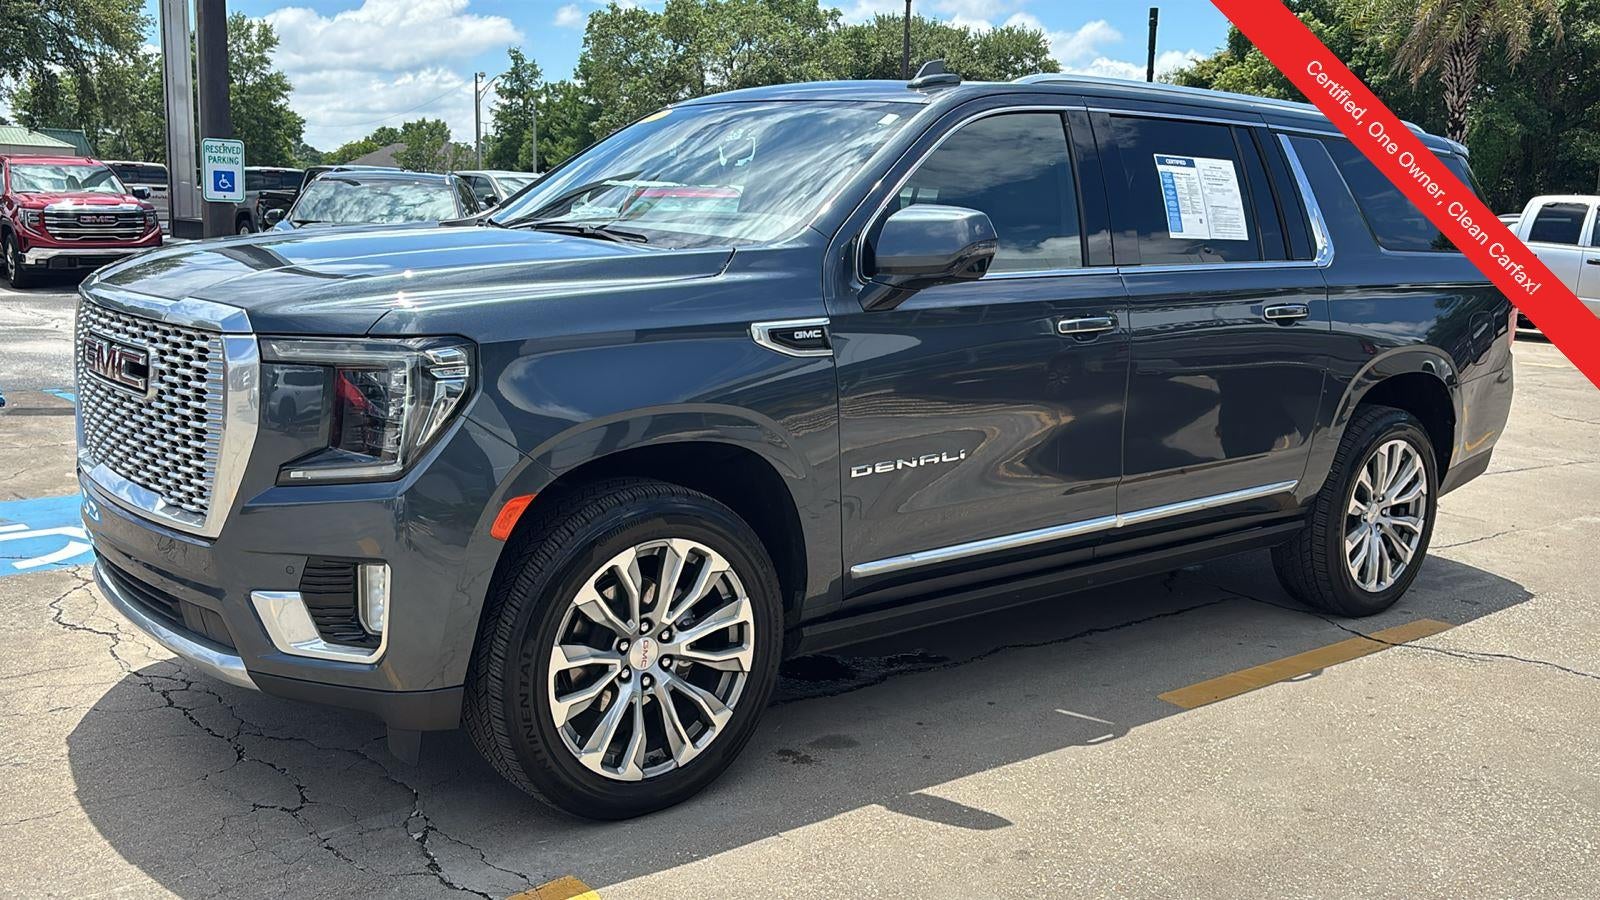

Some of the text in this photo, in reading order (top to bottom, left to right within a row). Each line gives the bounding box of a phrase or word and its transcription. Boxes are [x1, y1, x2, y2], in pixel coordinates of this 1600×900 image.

[205, 144, 241, 155] RESERVED
[208, 155, 240, 165] PARKING
[80, 215, 116, 223] GMC
[794, 329, 822, 340] GMC
[83, 337, 146, 388] GMC
[850, 449, 966, 479] DENALI
[641, 639, 649, 669] GMC
